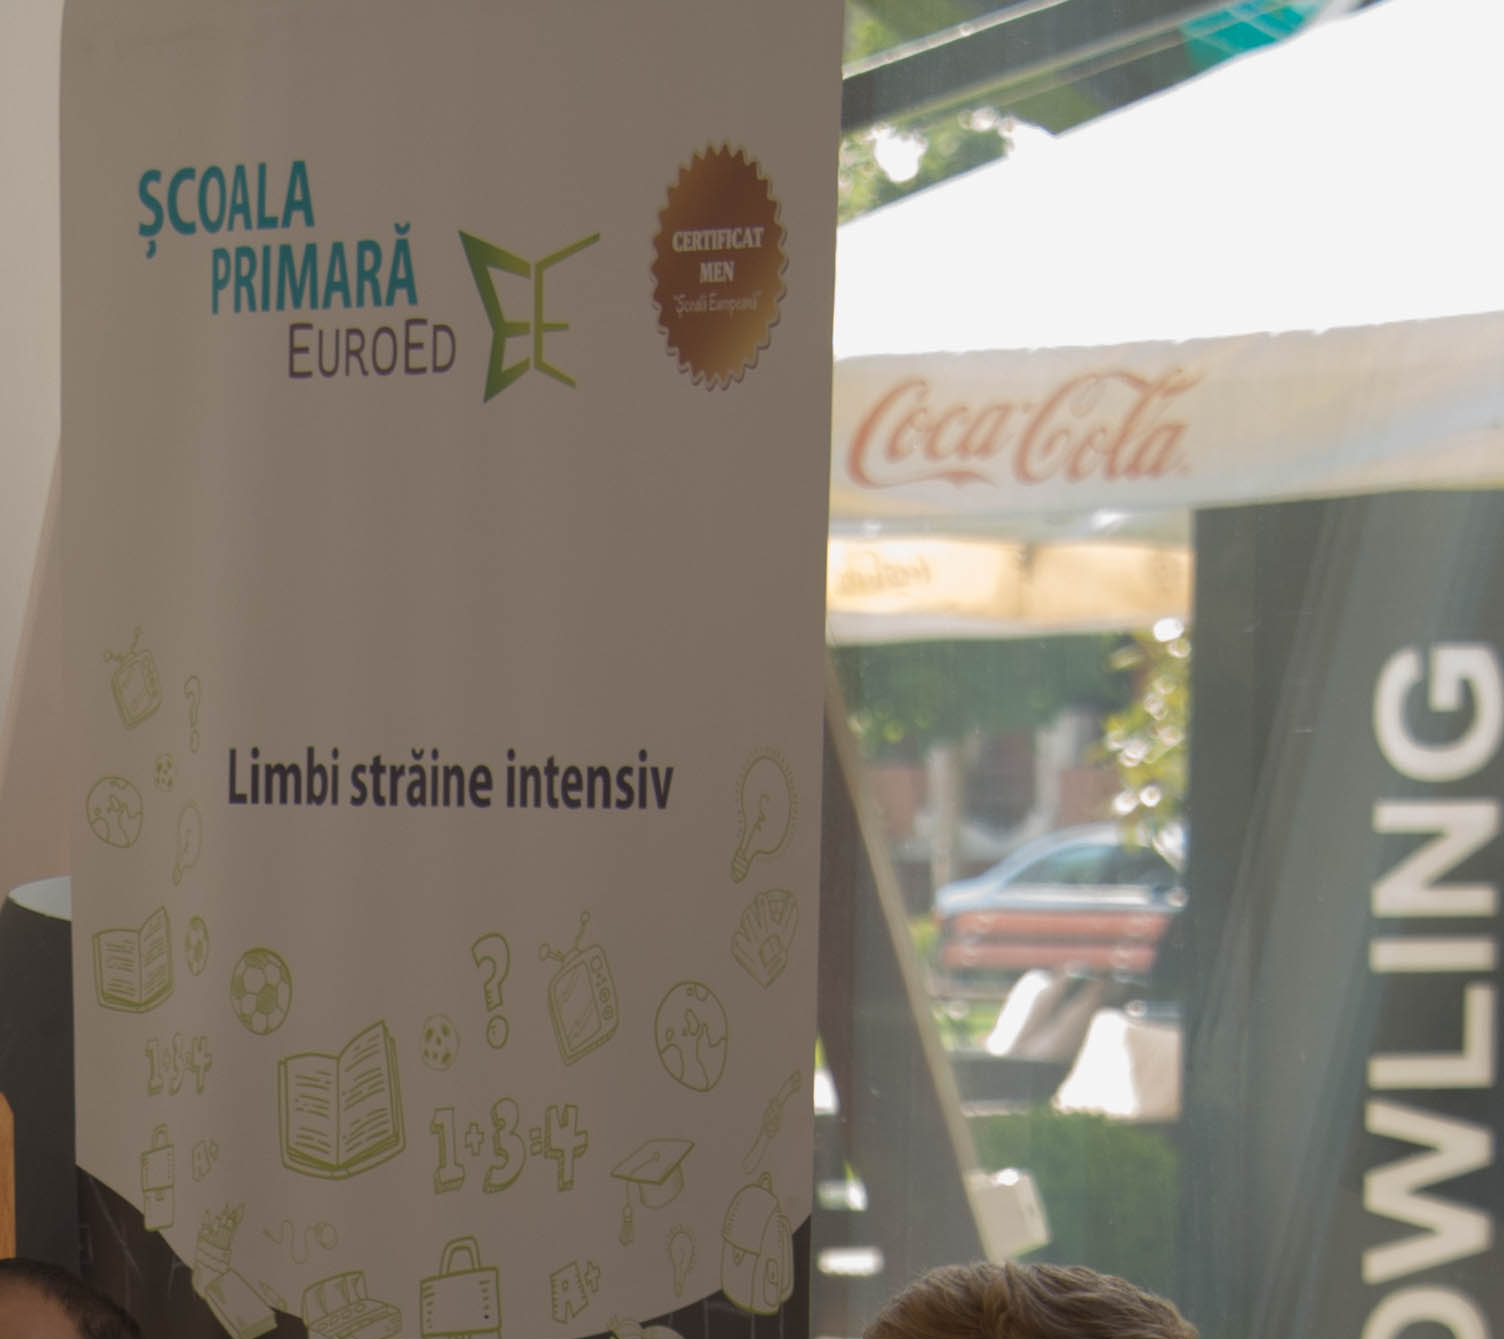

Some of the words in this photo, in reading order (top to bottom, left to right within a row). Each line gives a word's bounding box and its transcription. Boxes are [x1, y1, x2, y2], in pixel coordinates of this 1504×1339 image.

[137, 160, 315, 259] ȘCOALA
[672, 227, 765, 253] CERTIFICAT
[211, 222, 418, 315] PRIMARĂ
[699, 260, 735, 284] MEN
[228, 746, 341, 807] Limbi
[350, 747, 494, 808] străine
[505, 748, 675, 811] intensiv
